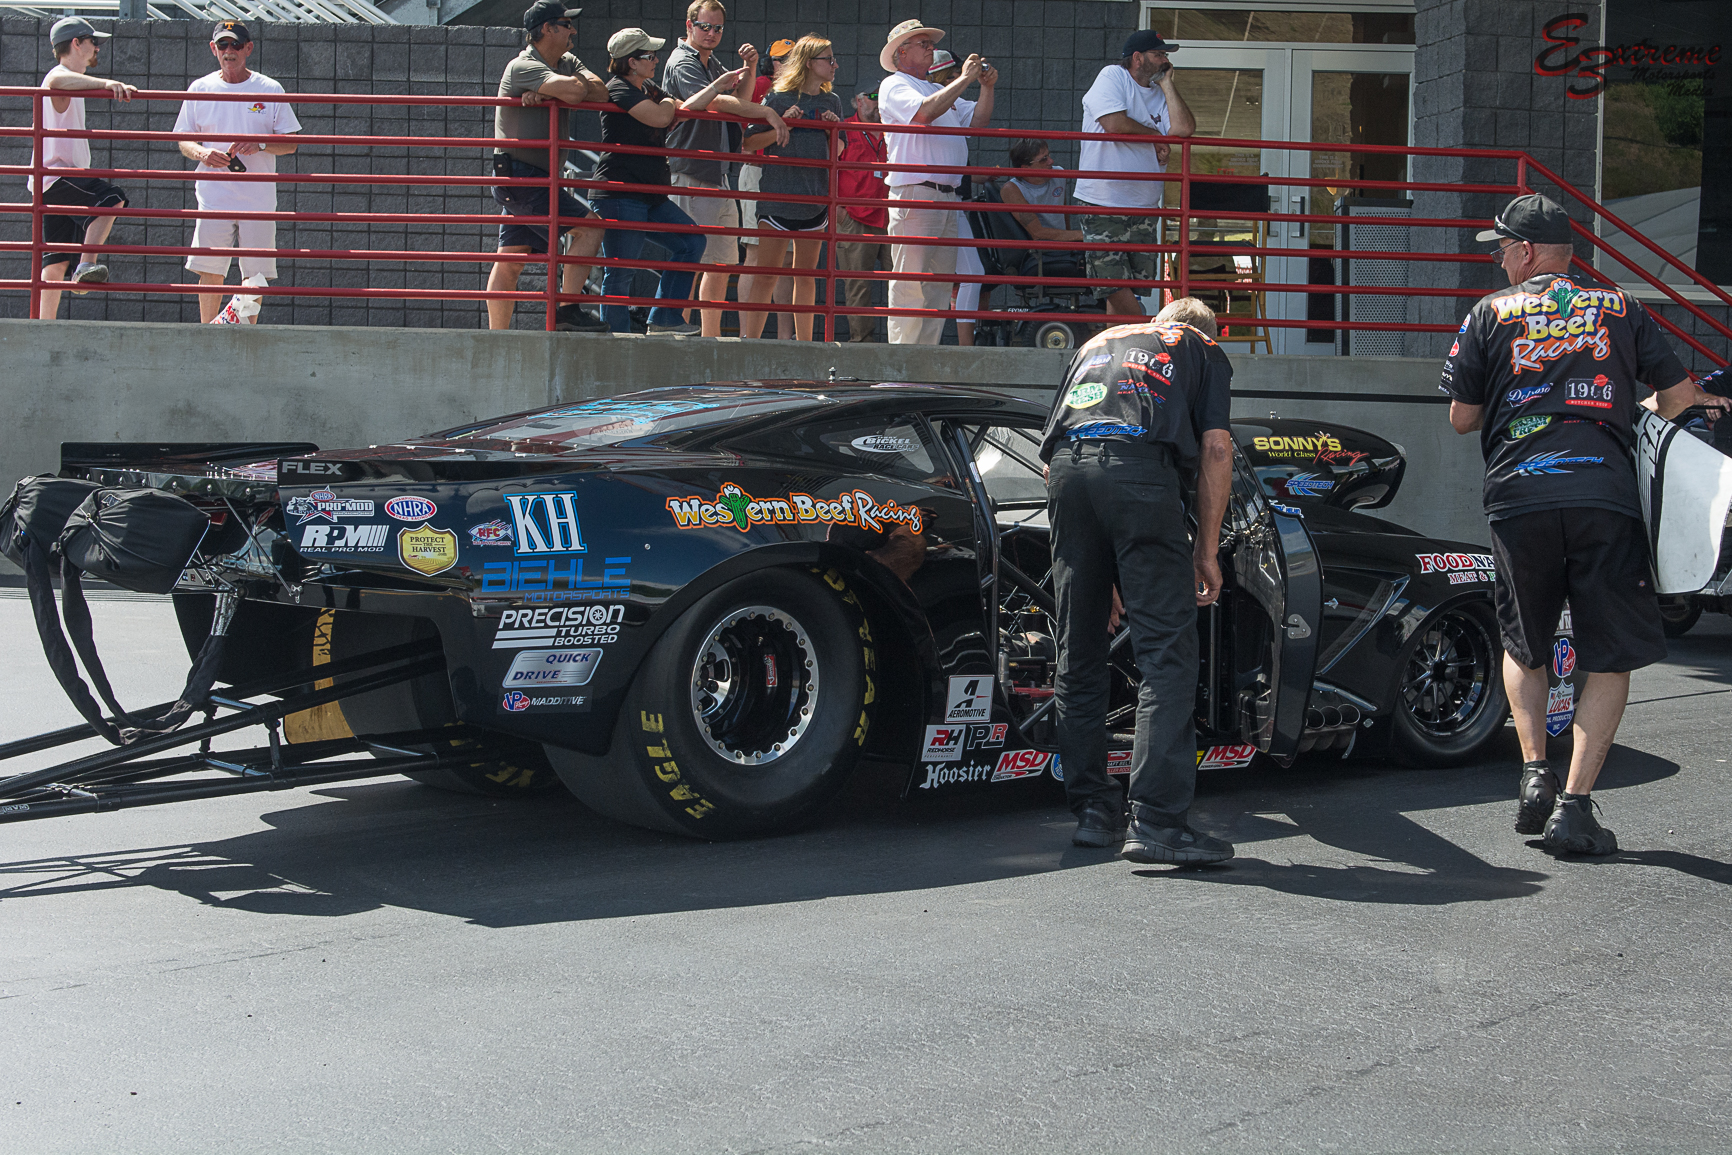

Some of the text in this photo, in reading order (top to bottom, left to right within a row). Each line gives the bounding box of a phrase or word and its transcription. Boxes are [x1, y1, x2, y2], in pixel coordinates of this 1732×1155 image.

[1491, 278, 1627, 325] Western
[1524, 307, 1602, 341] Beef
[1511, 325, 1611, 375] Racing
[1253, 435, 1342, 452] SONNY'S
[1312, 446, 1369, 467] Racing
[281, 461, 343, 477] FLEX
[1284, 479, 1336, 490] SPEEDTECH
[317, 501, 374, 511] PRO MOD
[393, 501, 430, 516] NHRA
[666, 484, 923, 534] Western Beef Racing
[478, 527, 501, 538] RFC
[505, 493, 587, 555] KH
[300, 525, 372, 547] RPM
[1415, 552, 1496, 574] FOODNA
[481, 557, 632, 593] BIEHLE
[1447, 571, 1497, 585] MEAT & P
[524, 588, 630, 602] MOTORSPORTS
[498, 604, 626, 629] PRECISION
[559, 624, 621, 635] TURBO
[554, 634, 618, 646] BOOSTED
[545, 652, 592, 664] QUICK
[512, 669, 561, 681] DRIVE
[503, 691, 523, 711] VP
[530, 696, 587, 706] MADDITIVE
[1548, 696, 1573, 714] LUCAS
[947, 708, 987, 719] AEROMOTIVE
[930, 729, 965, 746] RH
[995, 750, 1051, 773] MSD
[1205, 745, 1257, 762] MSD
[919, 759, 992, 790] Hoosier
